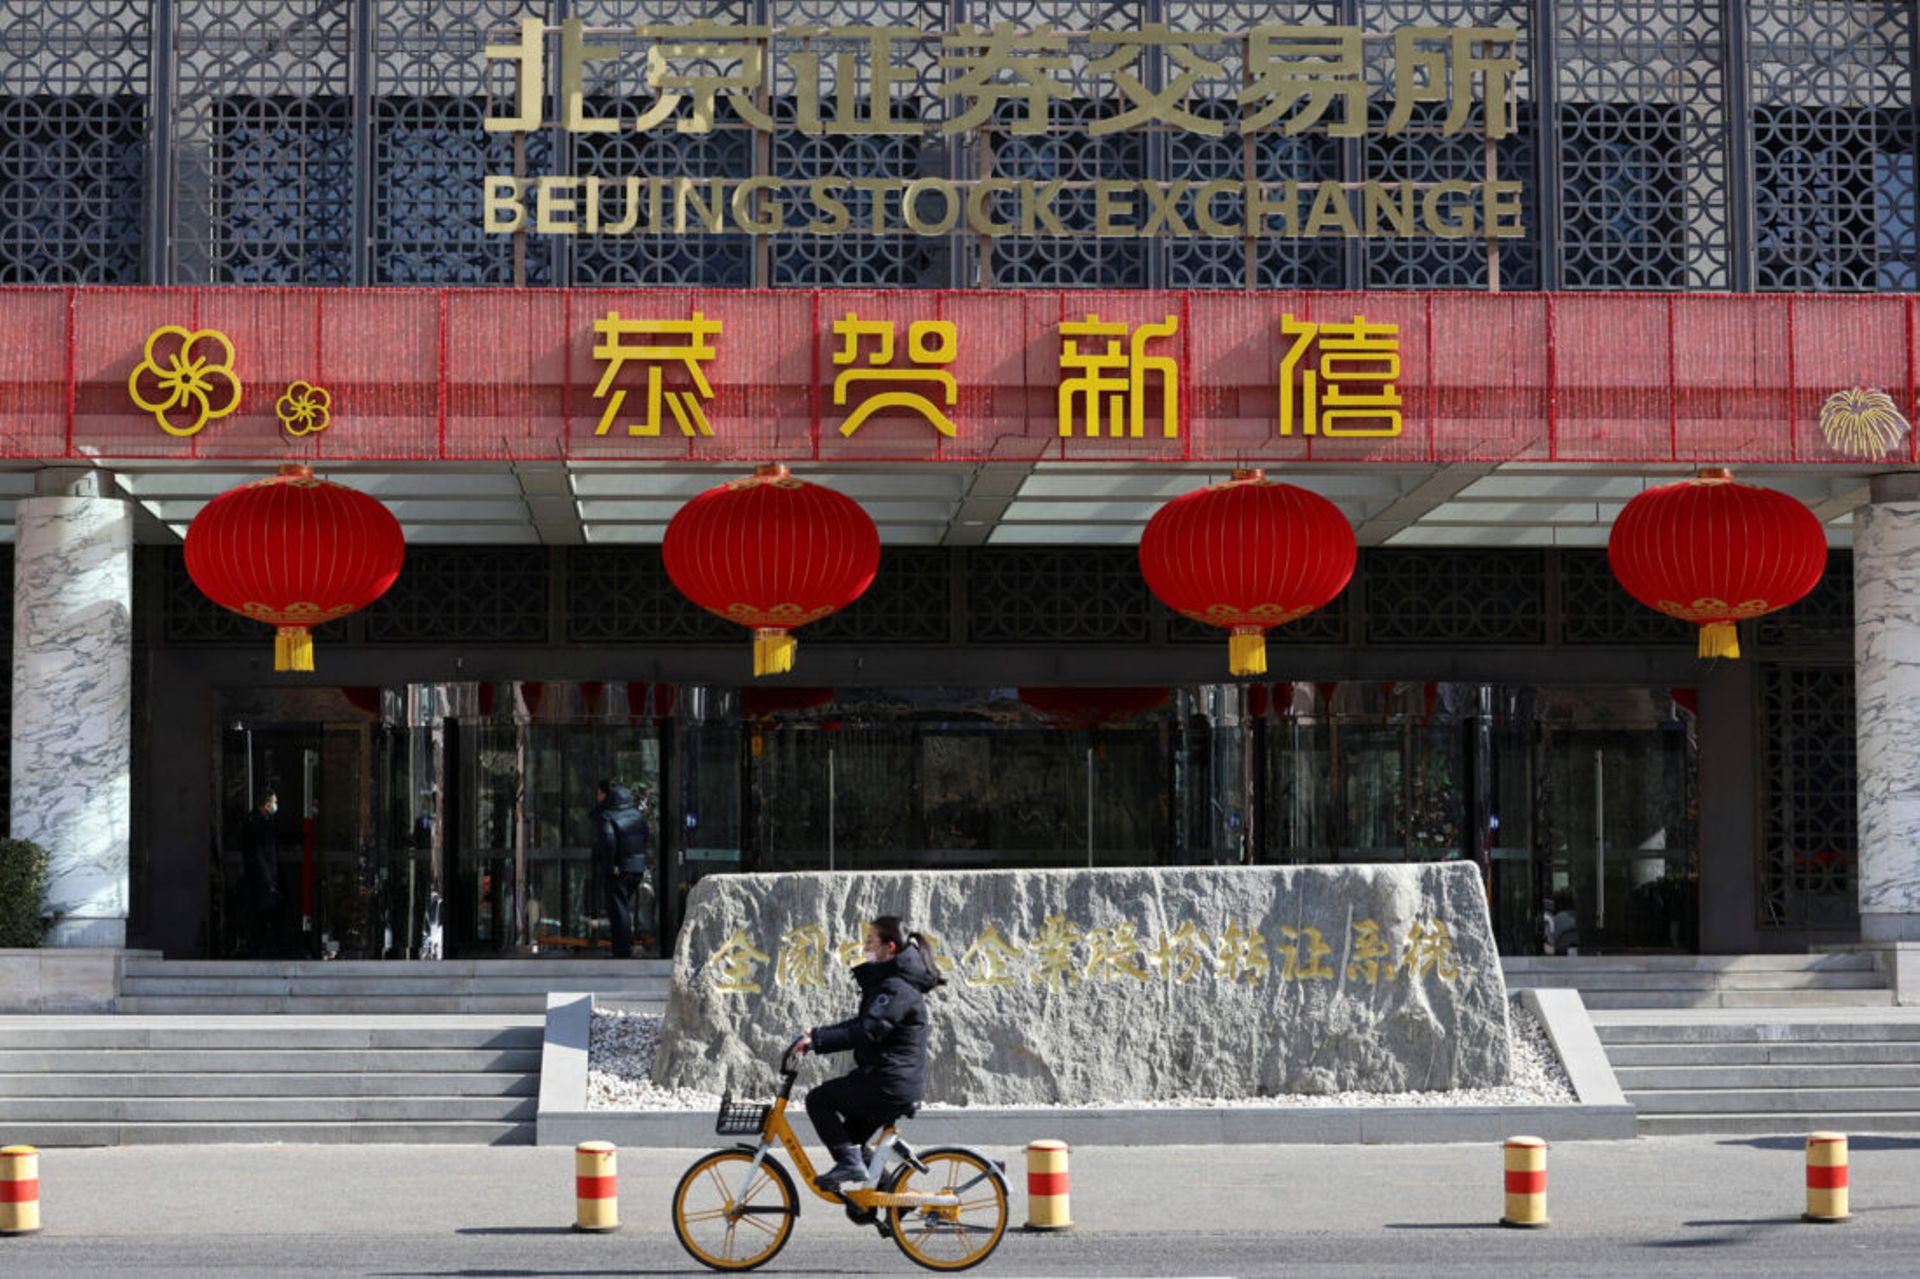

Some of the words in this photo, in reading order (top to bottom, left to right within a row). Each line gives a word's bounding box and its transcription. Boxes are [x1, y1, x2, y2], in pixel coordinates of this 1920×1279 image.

[484, 18, 1521, 138] 北京证券交易所
[483, 176, 783, 236] BEIJING
[808, 177, 1067, 237] STOCK
[1095, 179, 1526, 238] EXCHANGE
